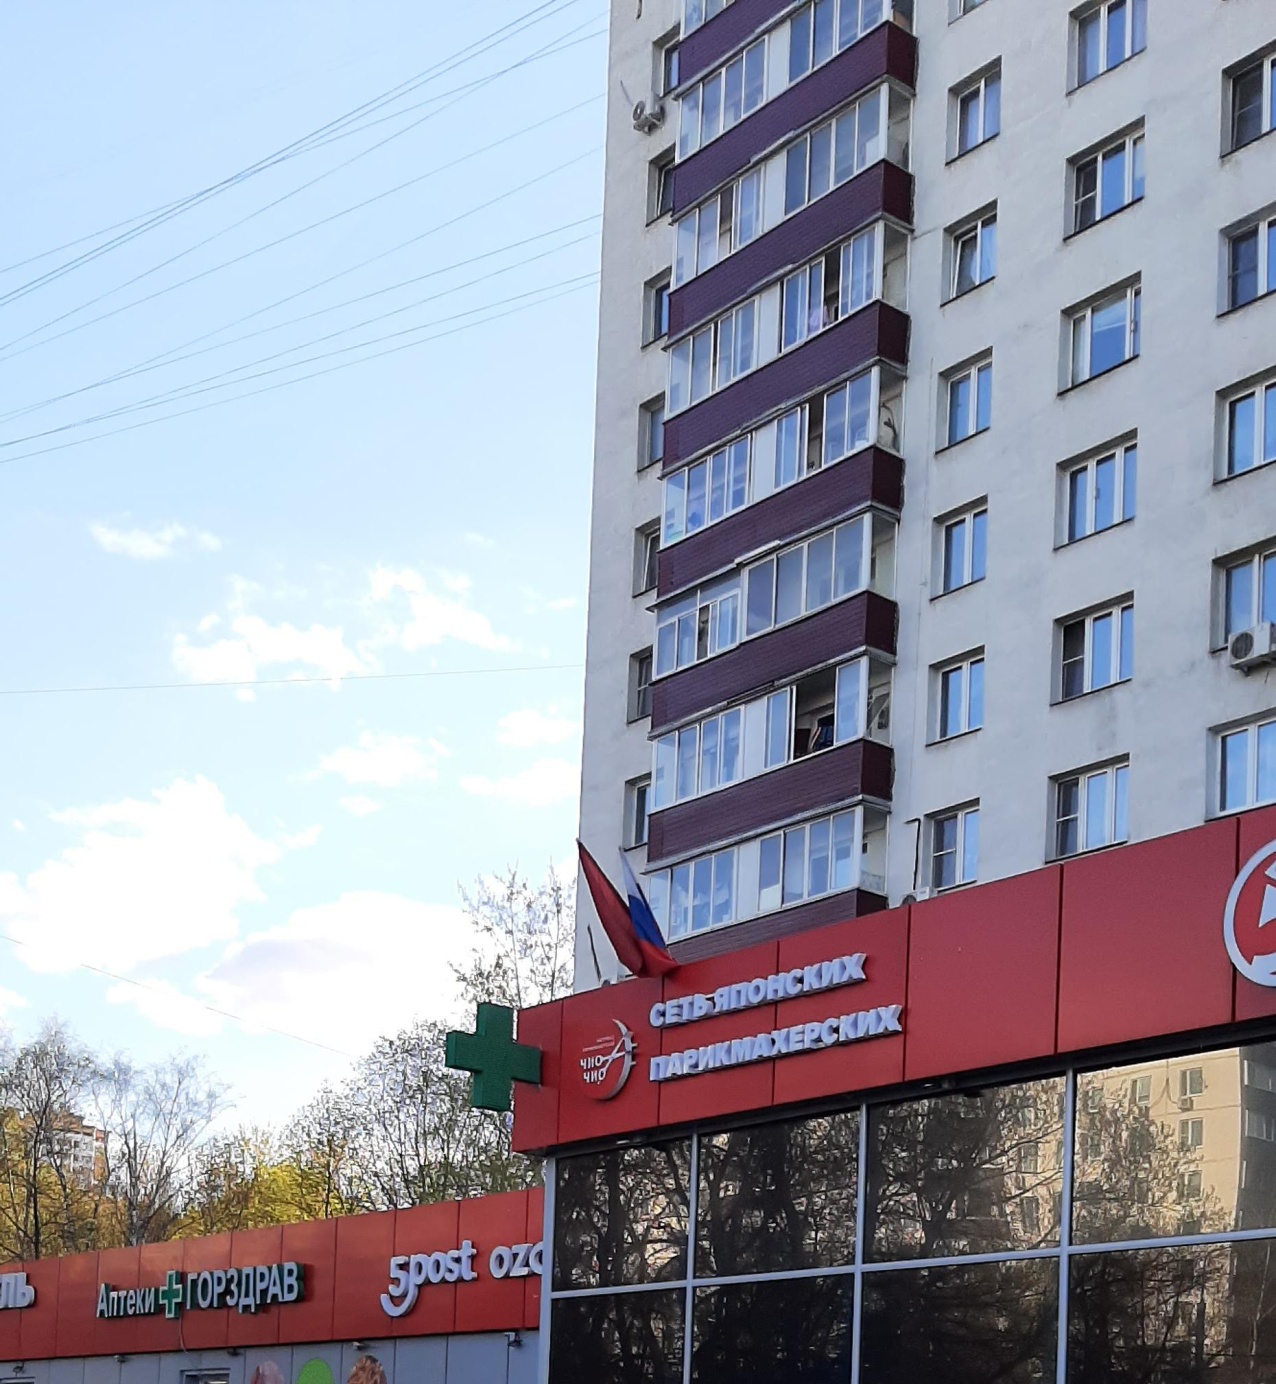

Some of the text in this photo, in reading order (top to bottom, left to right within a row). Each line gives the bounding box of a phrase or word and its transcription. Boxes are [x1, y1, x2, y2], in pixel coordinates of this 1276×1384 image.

[650, 952, 867, 1027] СЕТЬ ЯПОНСКИХ
[649, 1004, 903, 1081] ПАРИКМАХЕРСКИХ
[96, 1261, 299, 1318] Аптеки ГОРЗДРАВ
[379, 1239, 478, 1317] 5post
